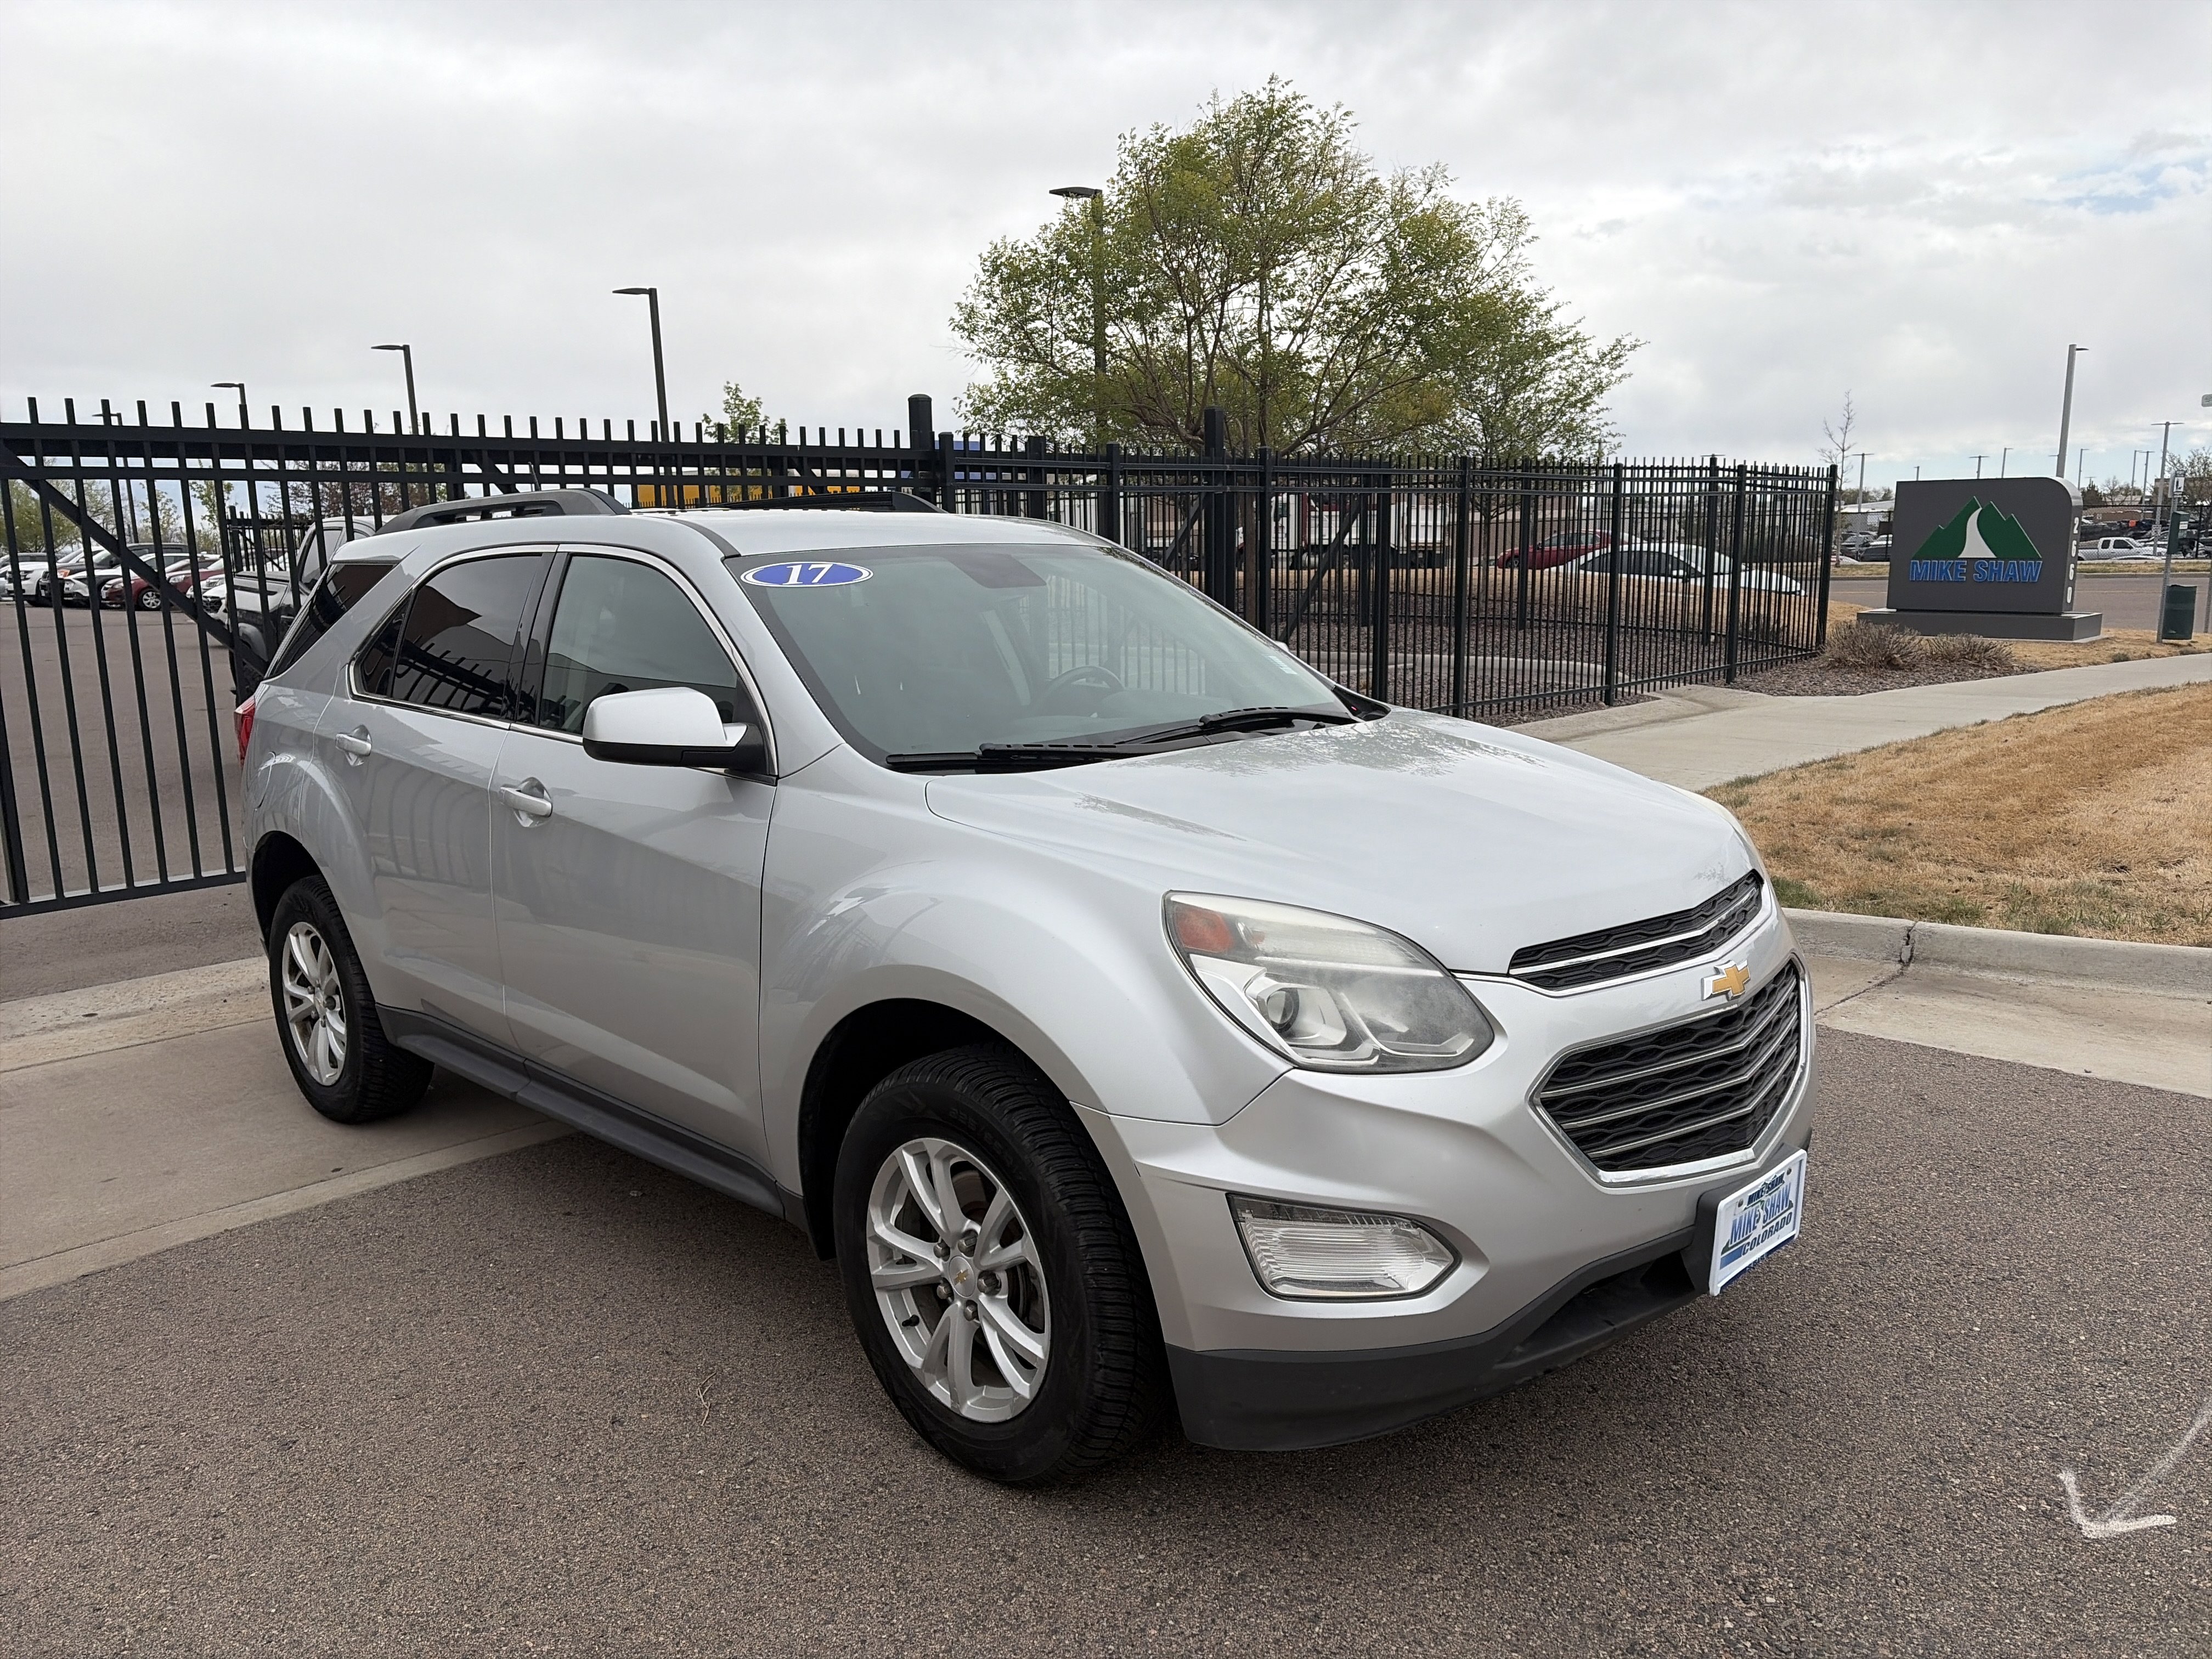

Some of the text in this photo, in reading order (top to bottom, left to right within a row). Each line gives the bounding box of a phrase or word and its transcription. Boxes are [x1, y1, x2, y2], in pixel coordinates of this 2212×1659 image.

[782, 563, 834, 585] 17
[1909, 560, 2042, 582] MIKE SHAW
[2067, 517, 2079, 603] 2660
[1747, 1172, 1785, 1206] MIKE SHAW
[1730, 1182, 1791, 1245] MIKE SHAW
[1742, 1211, 1793, 1256] COLORADO
